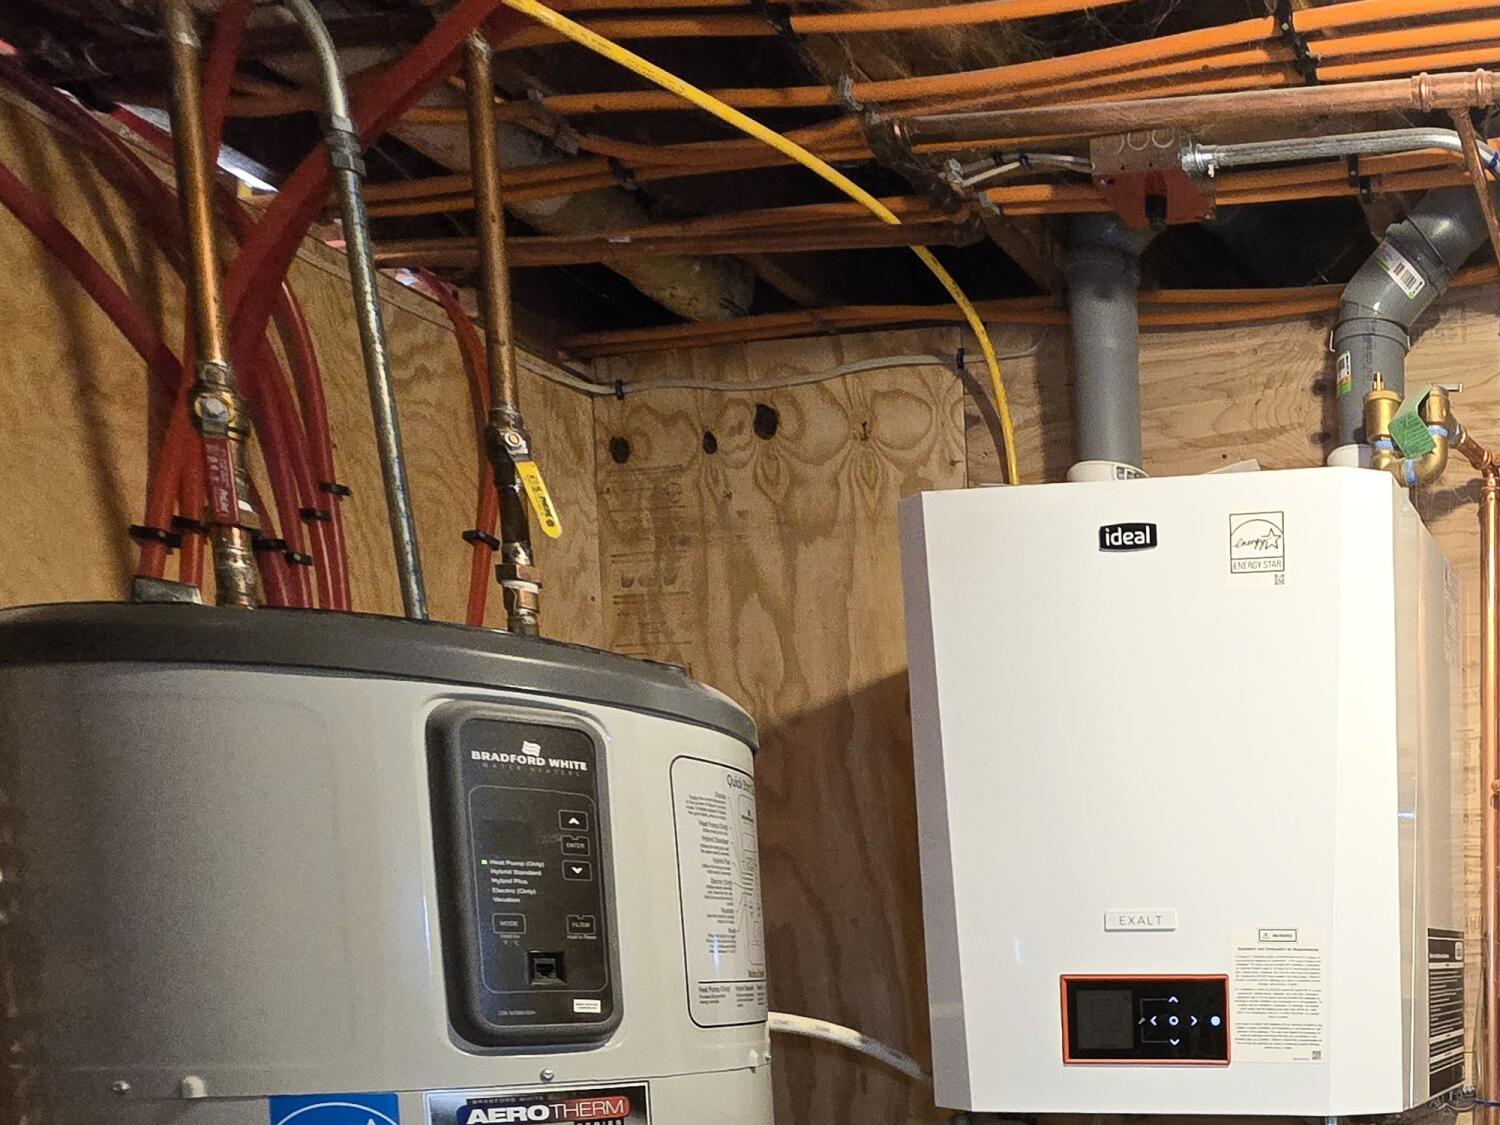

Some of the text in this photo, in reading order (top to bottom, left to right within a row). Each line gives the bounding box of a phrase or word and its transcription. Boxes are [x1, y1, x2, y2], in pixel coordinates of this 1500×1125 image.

[1104, 525, 1151, 547] ideal
[1233, 559, 1282, 571] ENERGY STAR
[471, 750, 588, 771] BRADFORD WHITE
[1119, 914, 1163, 926] EXALT
[466, 1098, 625, 1125] AEROTHERM
